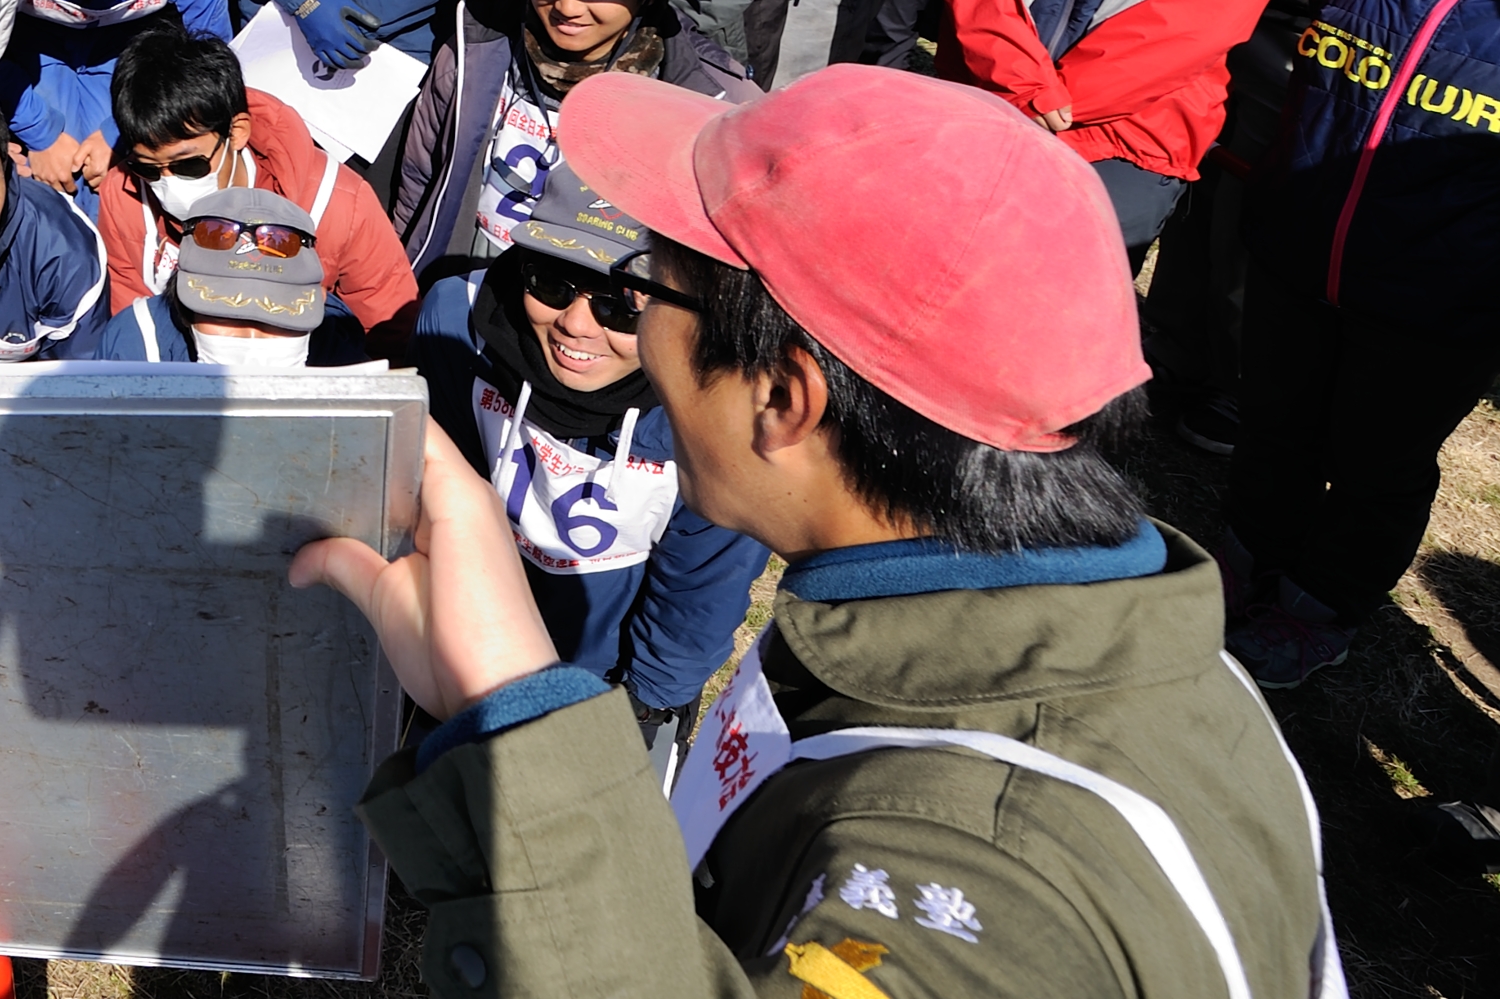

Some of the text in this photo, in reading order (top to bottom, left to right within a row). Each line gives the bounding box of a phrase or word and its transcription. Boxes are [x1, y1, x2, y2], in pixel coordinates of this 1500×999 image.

[494, 224, 515, 244] 日本
[576, 211, 639, 242] SOARING CLUB
[500, 442, 619, 559] 16
